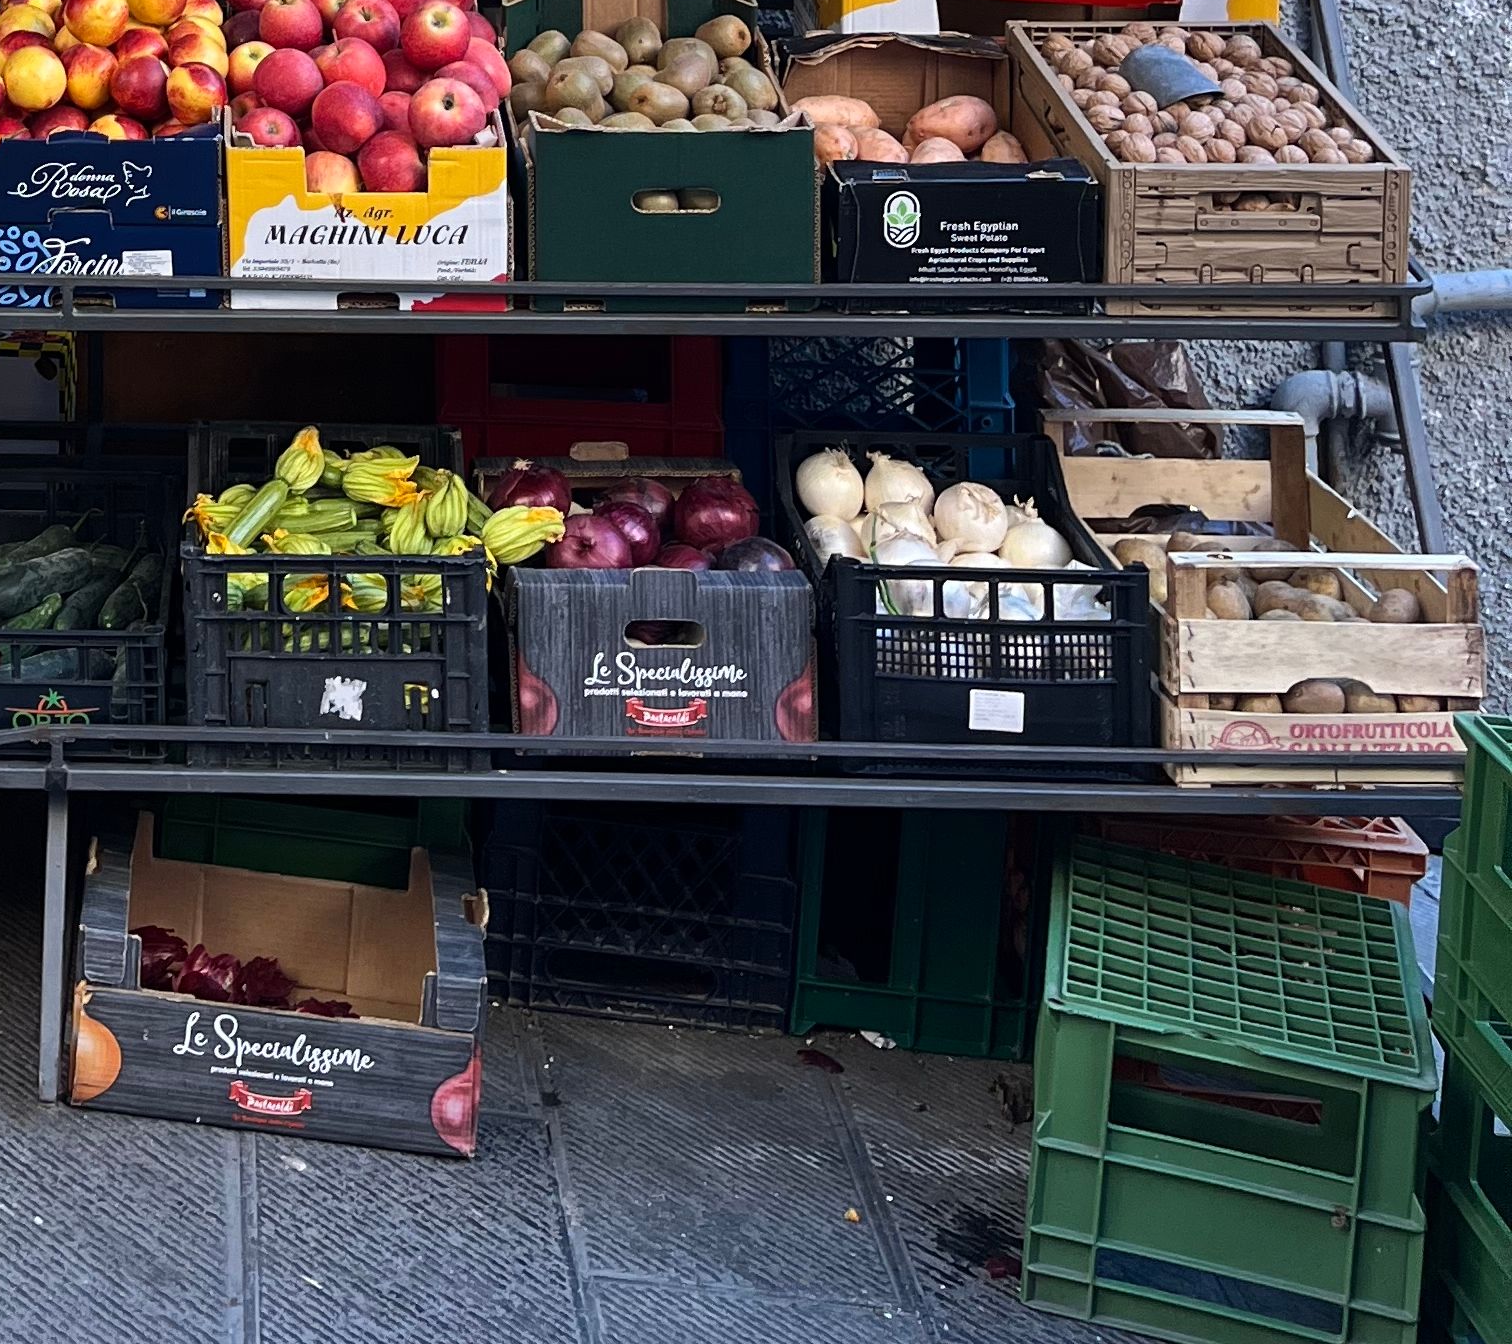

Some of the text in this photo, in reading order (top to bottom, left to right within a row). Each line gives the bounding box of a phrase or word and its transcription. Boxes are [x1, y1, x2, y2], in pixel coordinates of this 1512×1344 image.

[7, 162, 122, 204] Rosa
[69, 165, 115, 183] donna
[363, 206, 394, 220] Agr.
[264, 224, 469, 245] MAGHINI LUCA
[940, 221, 1019, 234] Fresh Egyptian
[950, 234, 1009, 243] Sweet Potato
[584, 651, 748, 689] Le Specialissime
[1289, 721, 1454, 740] ORTOFRUTTICOLA
[172, 1011, 376, 1074] Le Specialissime
